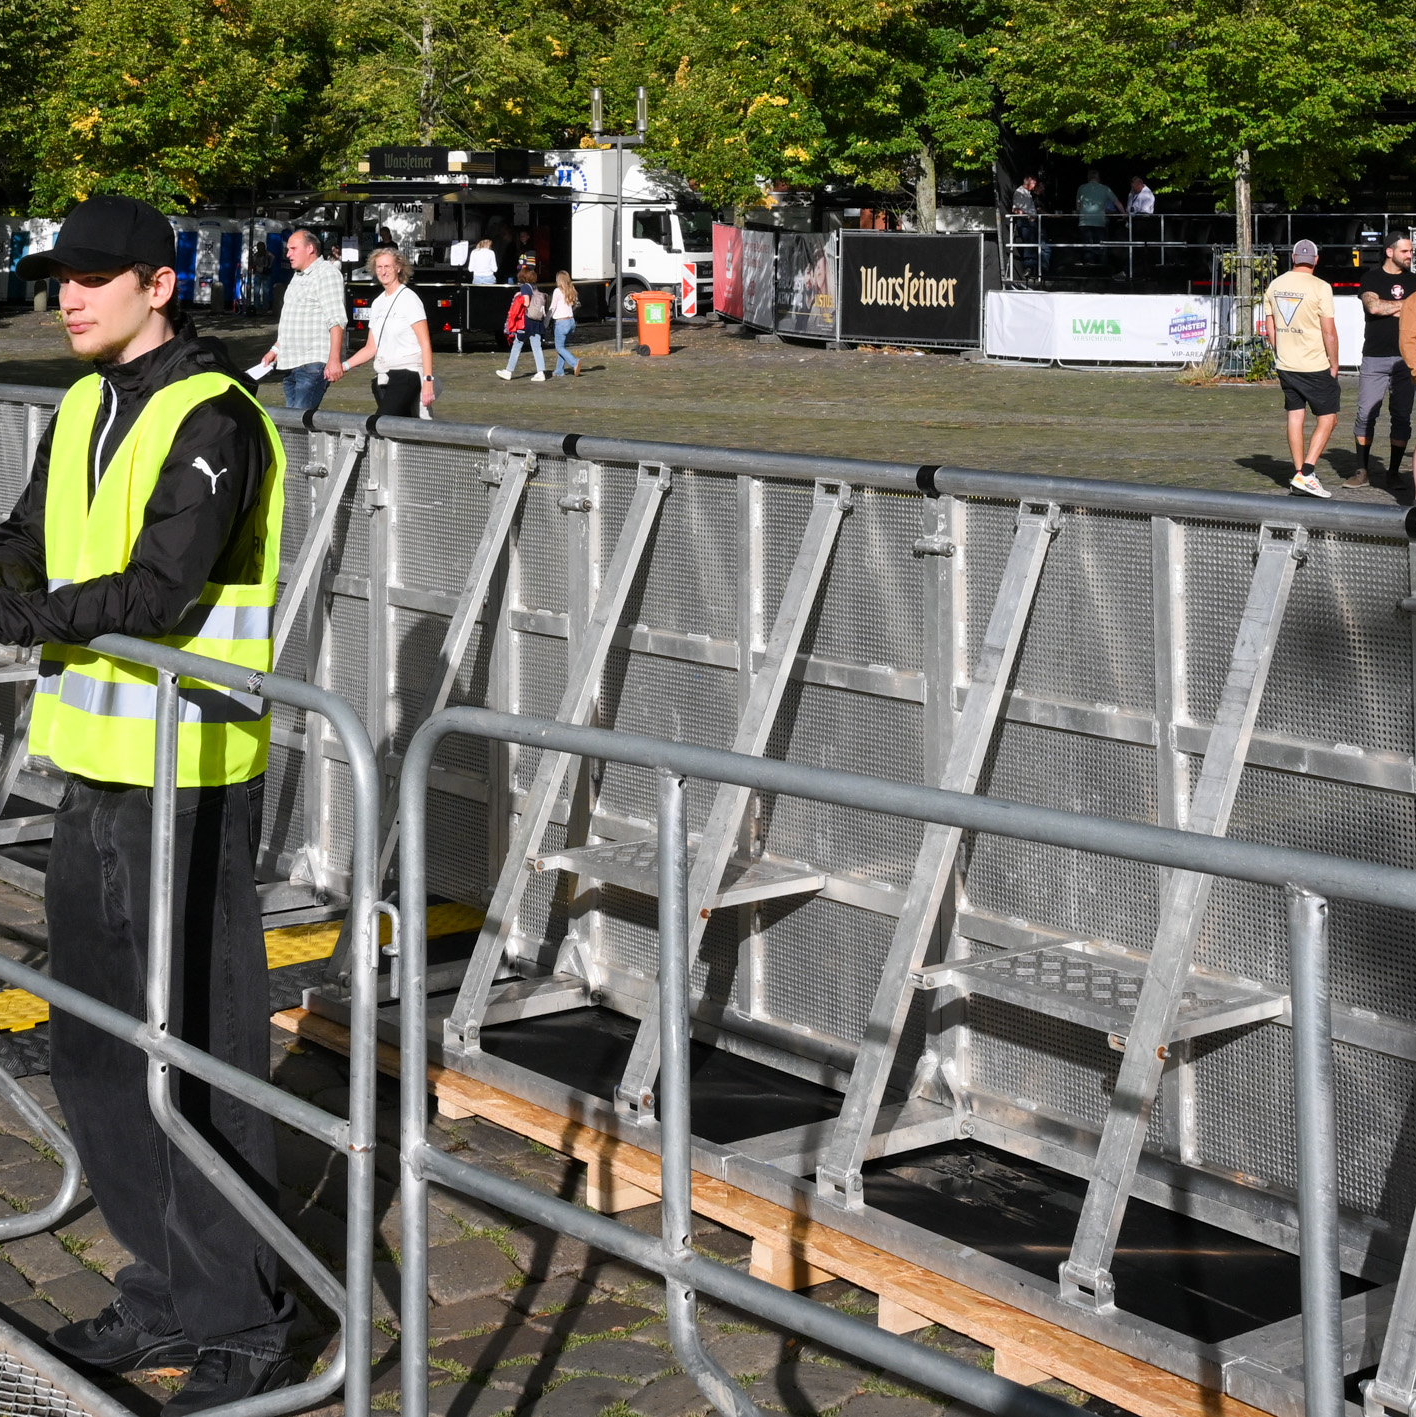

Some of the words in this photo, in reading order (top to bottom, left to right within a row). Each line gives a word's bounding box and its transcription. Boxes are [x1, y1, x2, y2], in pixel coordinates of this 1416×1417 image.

[384, 152, 433, 170] Warsteiner
[860, 263, 957, 312] Warsteiner
[1072, 319, 1105, 334] LVM
[1170, 321, 1206, 333] MÜNSTER
